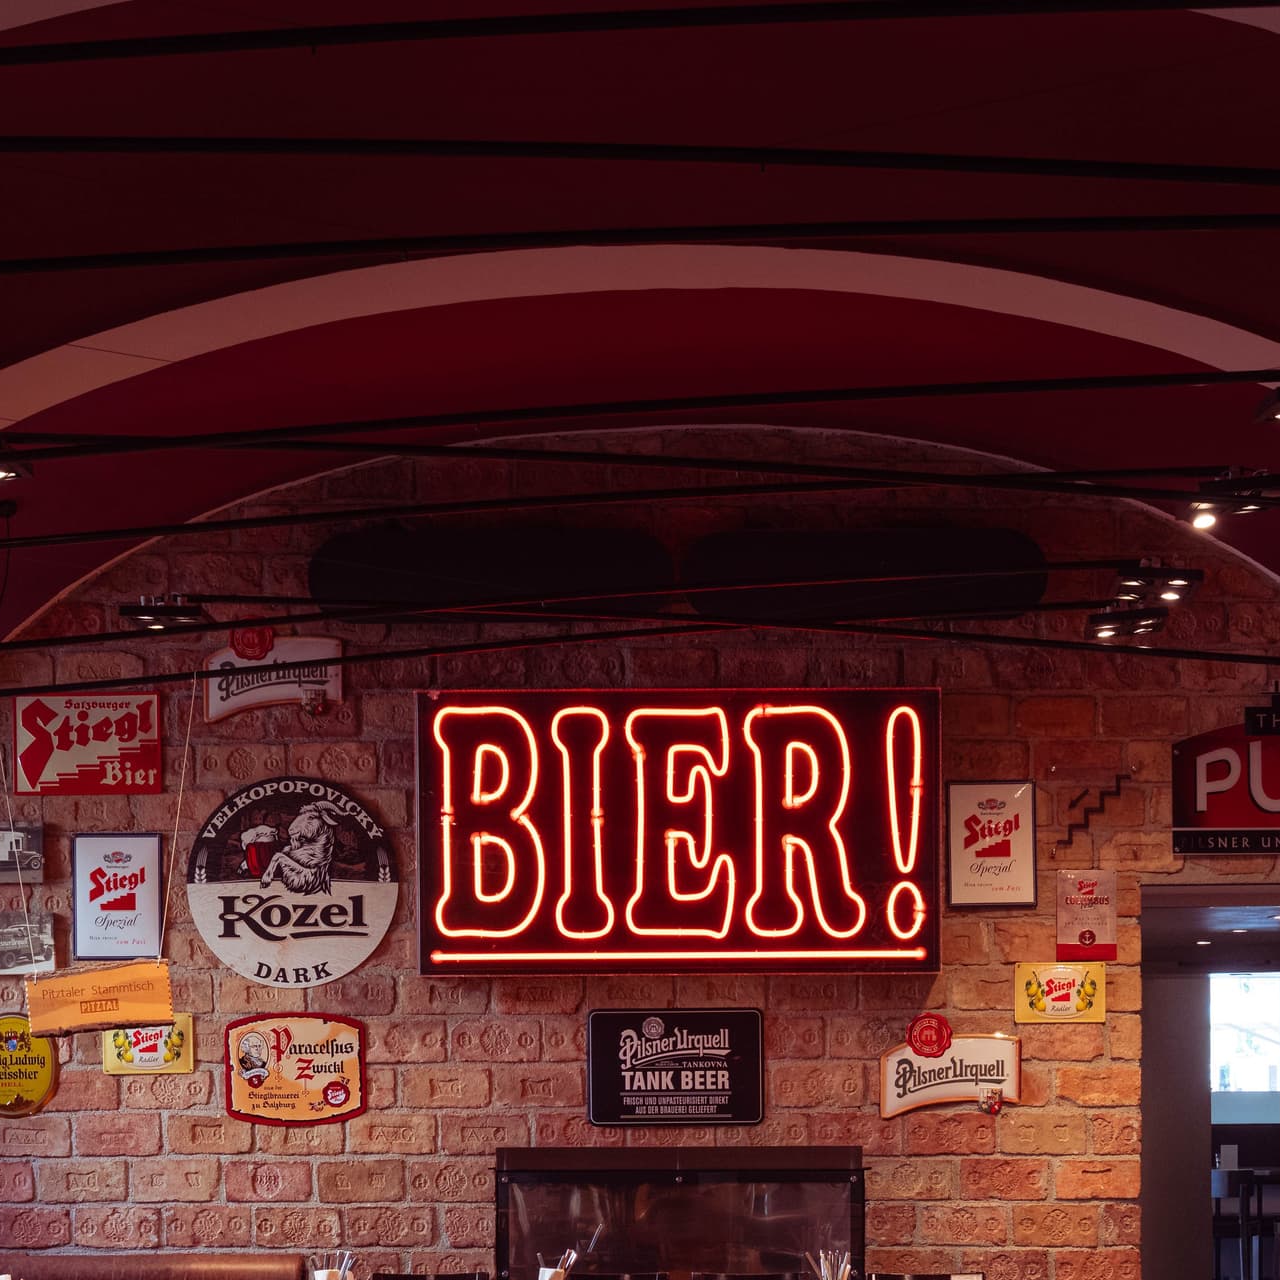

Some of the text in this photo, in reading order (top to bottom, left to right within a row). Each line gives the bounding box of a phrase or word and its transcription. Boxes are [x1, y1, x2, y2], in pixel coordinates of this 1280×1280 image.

[64, 699, 131, 711] Salzburger
[19, 698, 153, 790] Stiegl
[100, 761, 157, 785] Bier
[433, 706, 926, 940] BIER!
[963, 813, 1019, 850] Stiegl
[970, 859, 1016, 877] Spezial
[89, 866, 145, 902] Stiegl
[95, 913, 143, 931] Spezial
[217, 895, 369, 941] Kozel
[254, 961, 333, 983] DARK
[42, 980, 154, 1001] Pitztaler Stammtisch
[1045, 978, 1075, 997] Stiegl
[81, 1000, 119, 1013] PITZTAL
[133, 1029, 163, 1048] Stiegl
[618, 1027, 730, 1070] Pilsner Urquell
[9, 1054, 45, 1068] Ludwig
[295, 1058, 344, 1080] Zwickl
[622, 1071, 730, 1090] TANK BEER
[894, 1056, 1006, 1098] Pilsner Urquell
[623, 1096, 643, 1105] FRISCH
[644, 1096, 656, 1105] UND
[709, 1096, 729, 1105] DIREKT
[635, 1105, 718, 1114] AUS DER BRAUEREI GELIEFERT
